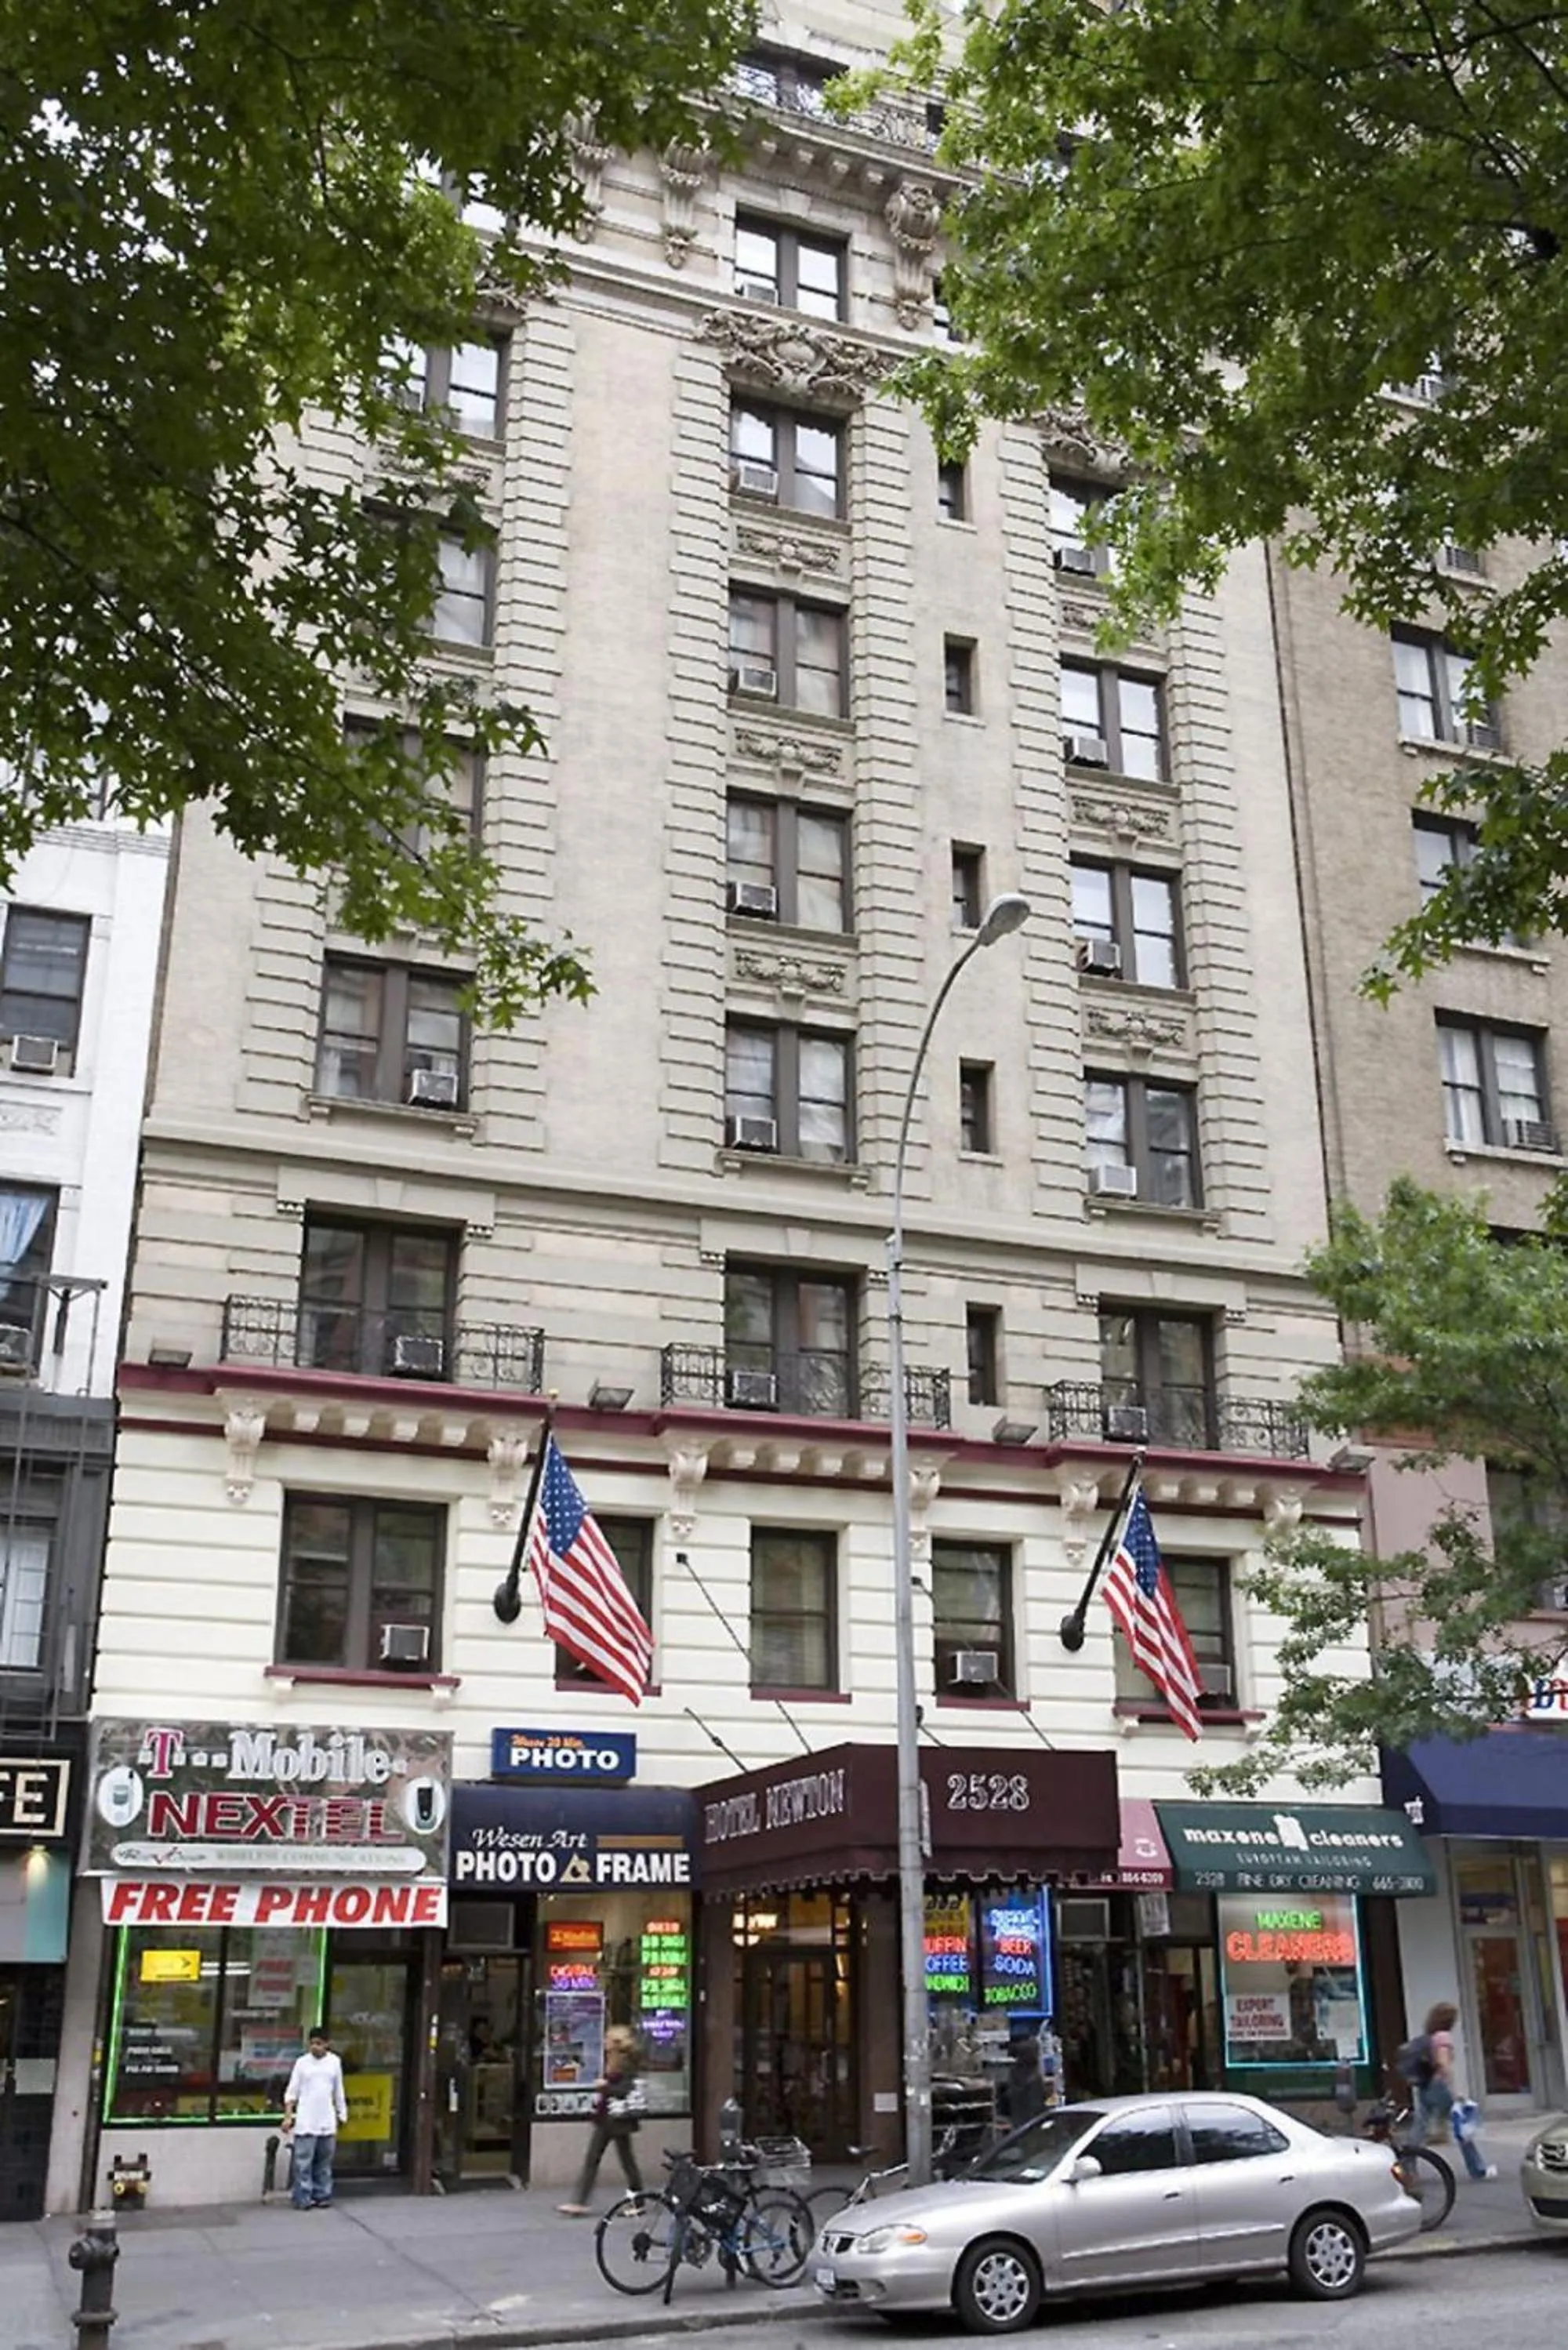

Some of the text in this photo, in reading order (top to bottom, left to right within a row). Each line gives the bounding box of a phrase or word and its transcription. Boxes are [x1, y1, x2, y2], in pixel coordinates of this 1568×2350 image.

[510, 1748, 619, 1770] PHOTO
[946, 1773, 1030, 1811] 2528
[148, 1791, 405, 1843] NEXTEL
[705, 1768, 845, 1844] HOTEL NEWTON
[471, 1826, 587, 1849] Wesen Art
[1182, 1828, 1404, 1848] maxene cleaners
[456, 1851, 691, 1883] PHOTO FRAME
[108, 1882, 441, 1923] FREE PHONE
[1258, 1909, 1322, 1929] MAXENE
[1000, 1939, 1032, 1954] BEER
[1227, 1930, 1355, 1960] CLEANERS
[925, 1954, 970, 1972] OFFEE
[993, 1954, 1036, 1977] SODA
[985, 1982, 1036, 2004] TOBACCO
